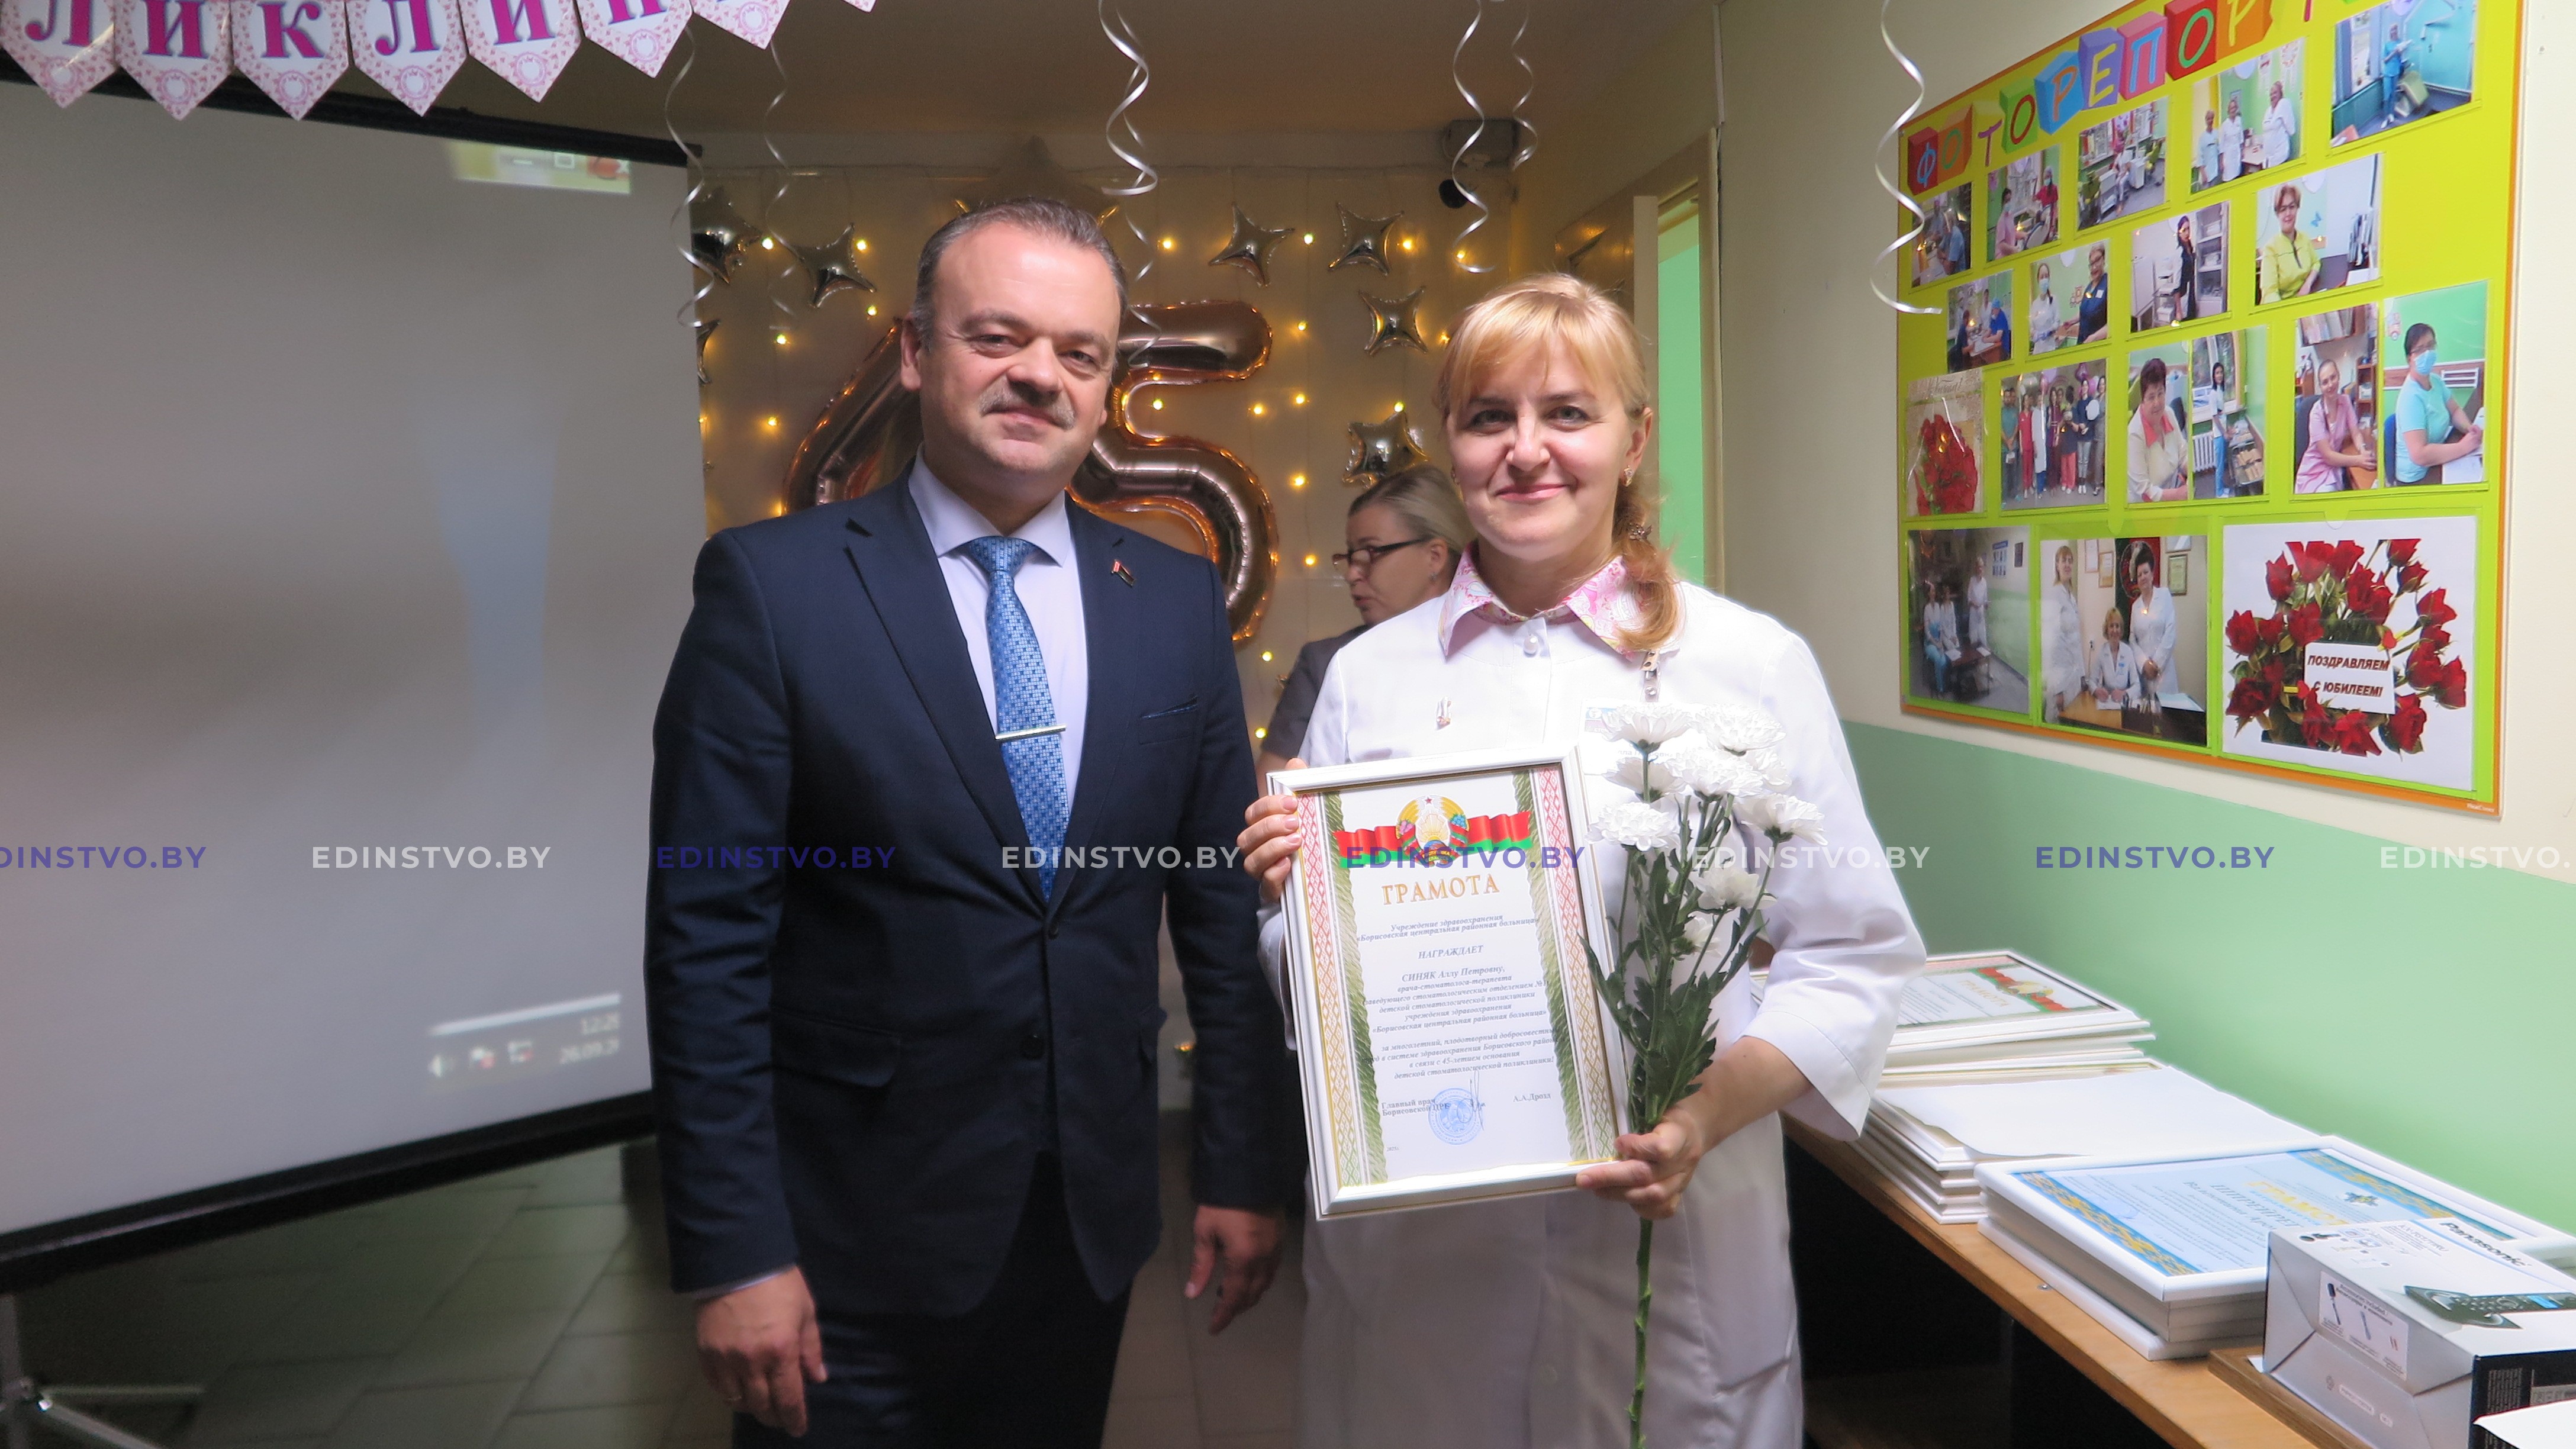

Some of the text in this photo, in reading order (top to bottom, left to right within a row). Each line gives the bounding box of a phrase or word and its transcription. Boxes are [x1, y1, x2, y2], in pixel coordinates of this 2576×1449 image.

[2307, 655, 2391, 671] ПОЗДРАВЛЯЕМ
[2313, 681, 2384, 698] С ЮБИЛЕЕМ!
[1382, 873, 1500, 905] ГРАМОТА
[1357, 932, 1408, 942] «Борисовская
[1410, 926, 1460, 936] центральная
[1461, 922, 1498, 932] районная
[1391, 915, 1503, 932] Учреждение здравоохранения
[1418, 945, 1484, 959] НАГРАЖДАЕТ
[1402, 965, 1505, 983] СИНЯК Аллу Петровну,
[1398, 975, 1512, 994] врача-стоматолога-терапевта
[1412, 988, 1487, 1001] стоматологическим
[1489, 983, 1534, 993] отделением
[1379, 992, 1535, 1014] детской стоматологической поликлиники
[1372, 1010, 1547, 1033] «Борисовская центральная районная больница»
[1405, 1004, 1512, 1022] учреждения здравоохранения
[1390, 1040, 1442, 1050] многолетний,
[1444, 1033, 1498, 1045] плодотворный
[1387, 1052, 1419, 1061] системе
[1420, 1046, 1481, 1058] здравоохранения
[1483, 1041, 1531, 1051] Борисовского
[1442, 1055, 1480, 1065] 45-летием
[1482, 1051, 1520, 1061] основания
[1394, 1056, 1554, 1080] детской стоматологической поликлиники!
[1382, 1099, 1416, 1109] Главный
[1513, 1093, 1551, 1103] А.А.Дрозд
[1382, 1105, 1431, 1116] Борисовской
[2438, 1222, 2526, 1267] Panasonic
